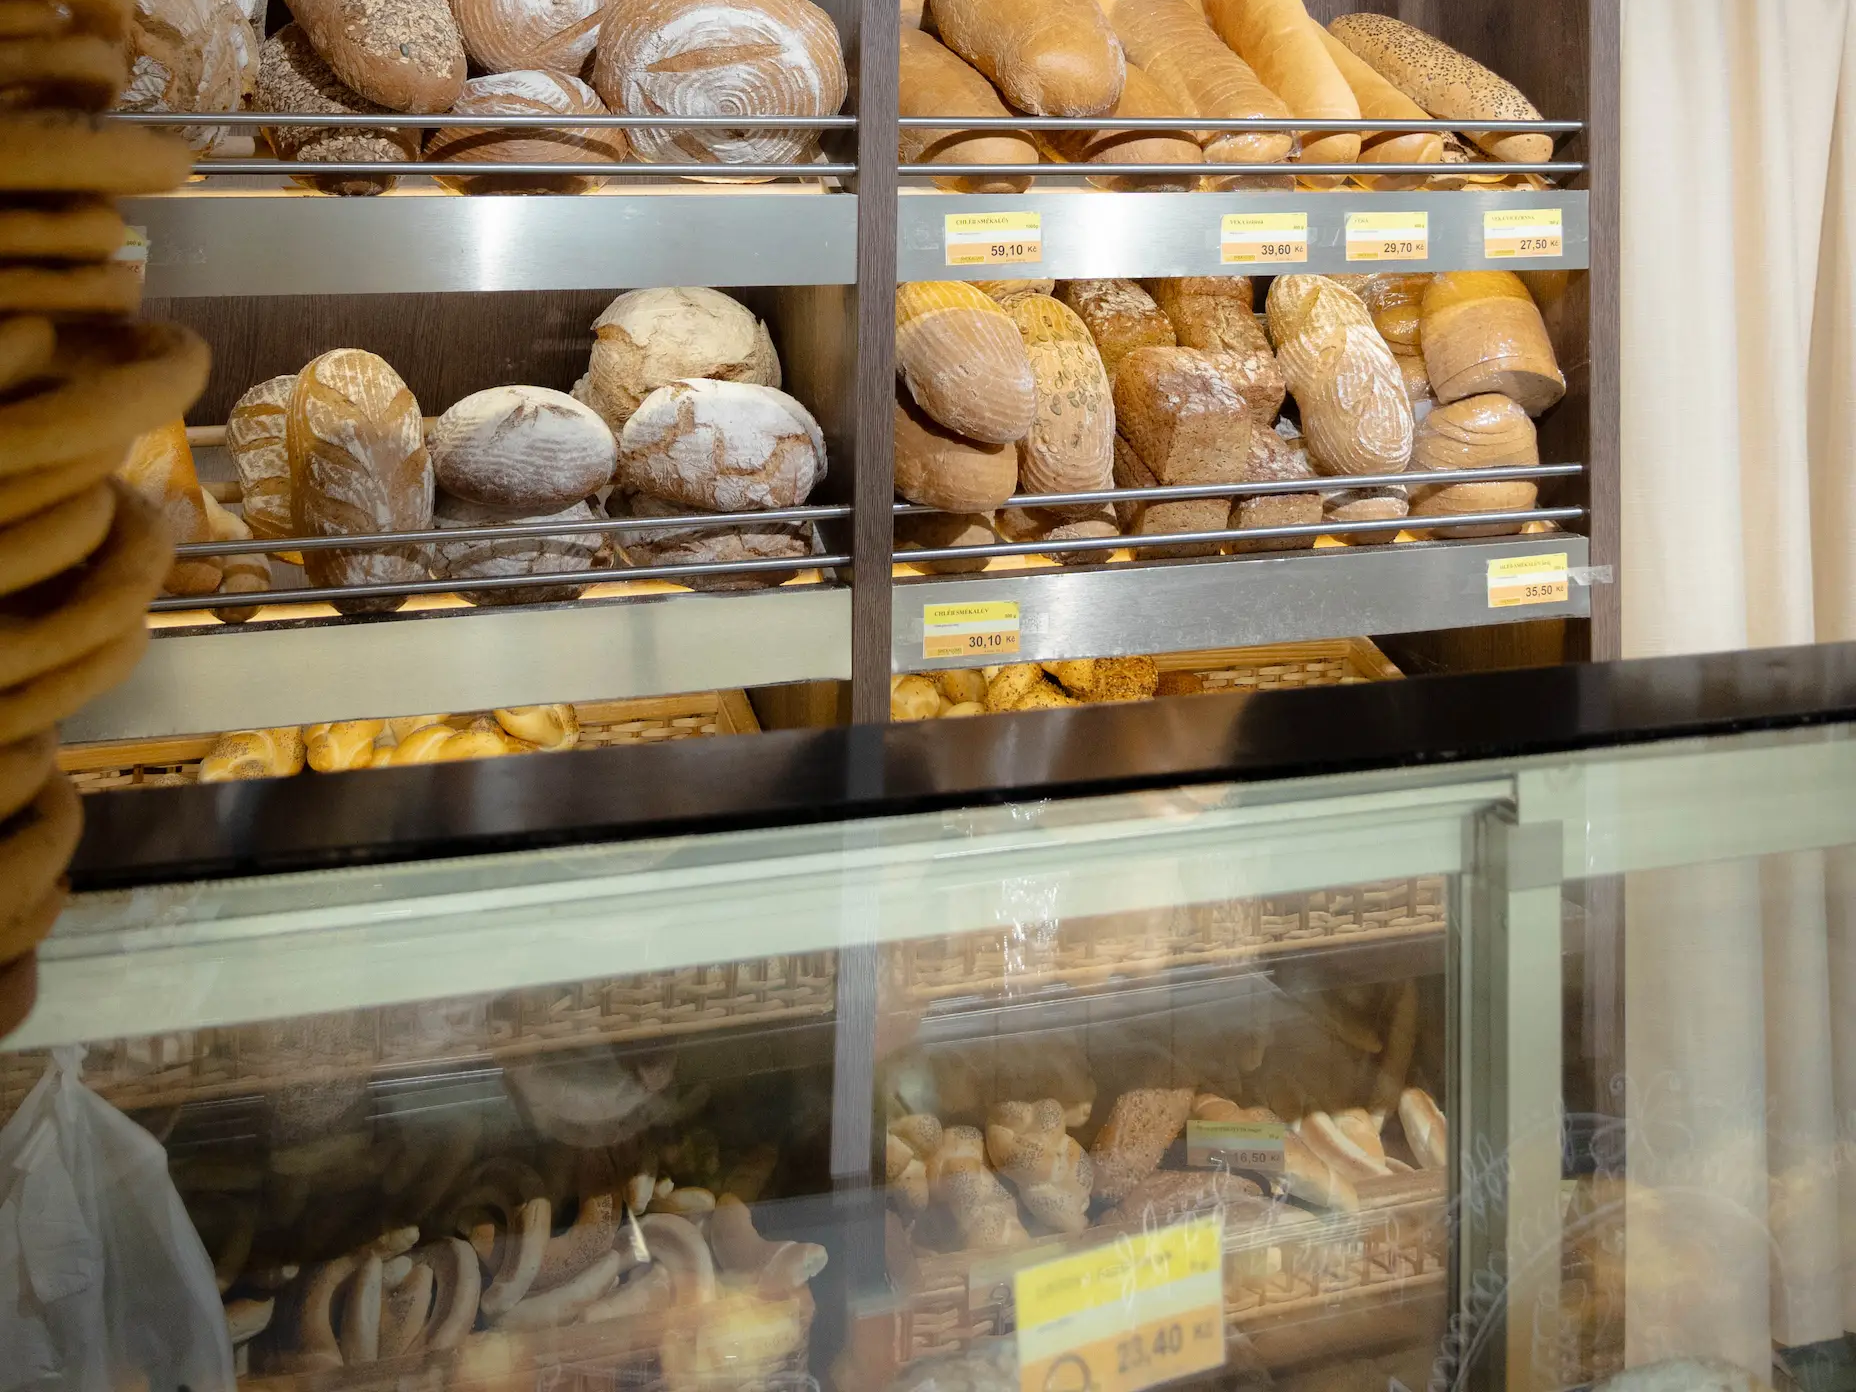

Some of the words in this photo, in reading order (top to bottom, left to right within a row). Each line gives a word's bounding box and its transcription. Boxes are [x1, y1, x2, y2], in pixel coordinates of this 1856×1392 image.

[991, 244, 1023, 257] 59,10
[1261, 244, 1291, 256] 39,60
[1384, 242, 1412, 254] 29,70
[1520, 239, 1547, 250] 27,50
[1525, 585, 1553, 597] 35,50
[969, 634, 1002, 648] 30,10
